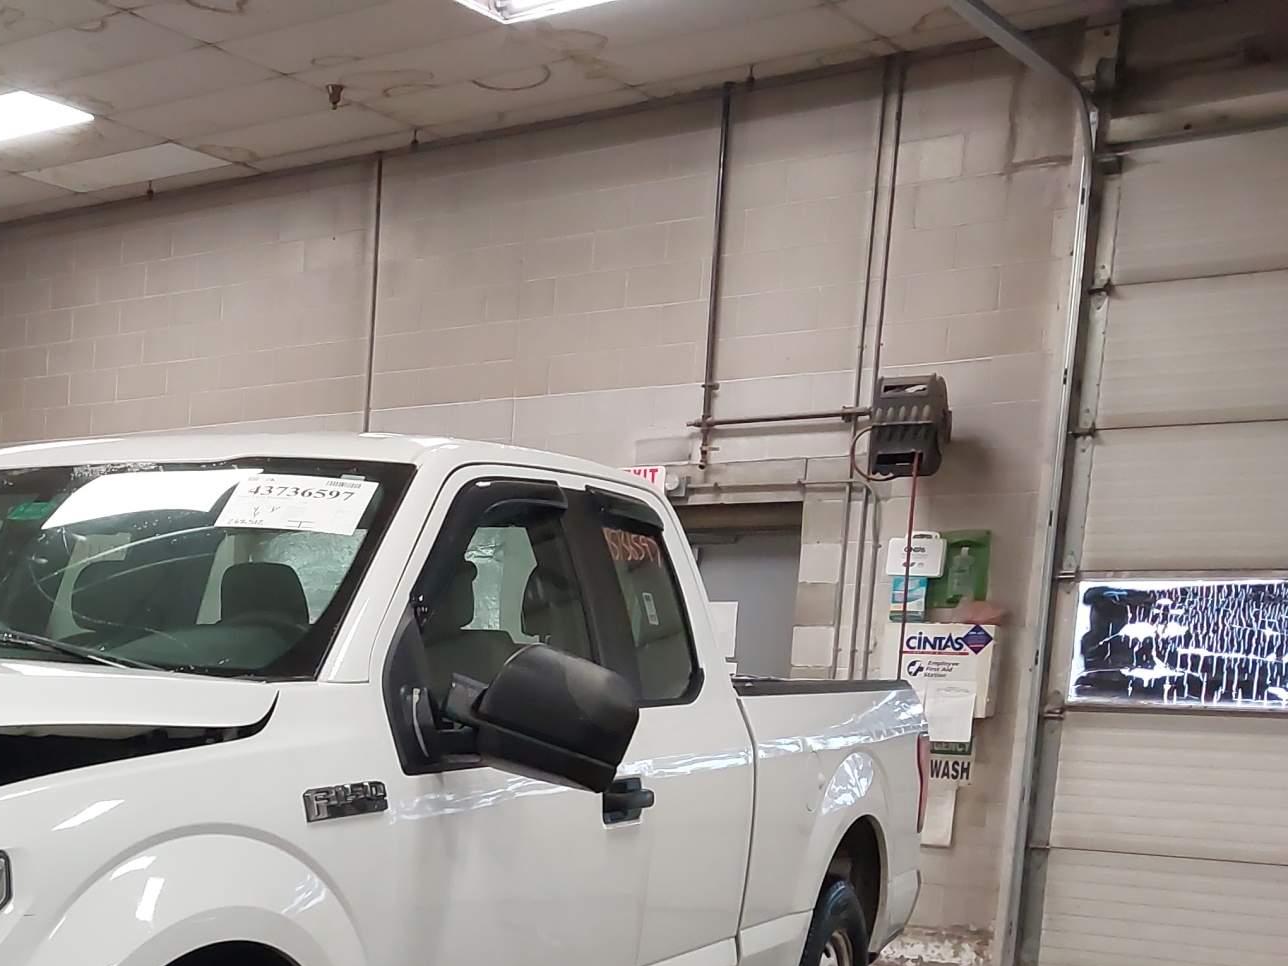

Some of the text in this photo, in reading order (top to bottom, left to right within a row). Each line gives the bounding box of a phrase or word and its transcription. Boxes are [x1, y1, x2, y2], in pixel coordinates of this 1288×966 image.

[623, 468, 659, 484] IT
[247, 485, 356, 502] 43736597
[930, 759, 971, 780] WASH
